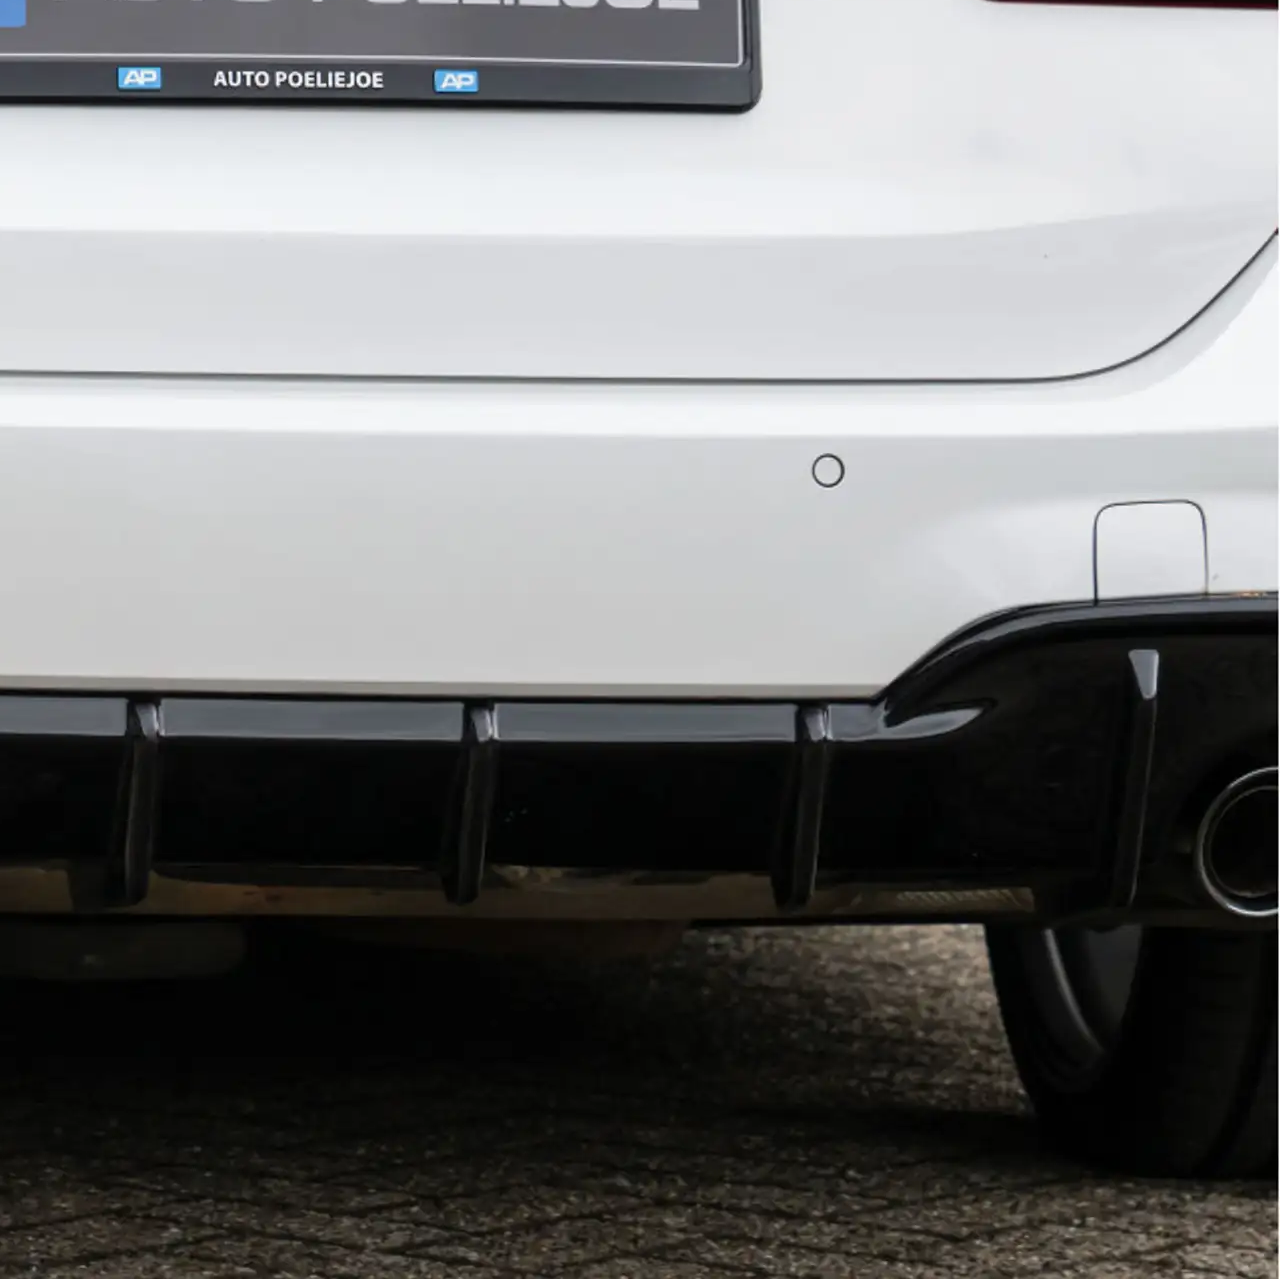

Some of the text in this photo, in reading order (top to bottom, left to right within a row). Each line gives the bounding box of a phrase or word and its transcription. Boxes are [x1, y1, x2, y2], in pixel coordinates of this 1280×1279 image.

[123, 69, 158, 86] AP
[213, 70, 384, 89] AUTO POELIEJOE
[440, 72, 475, 90] AP
